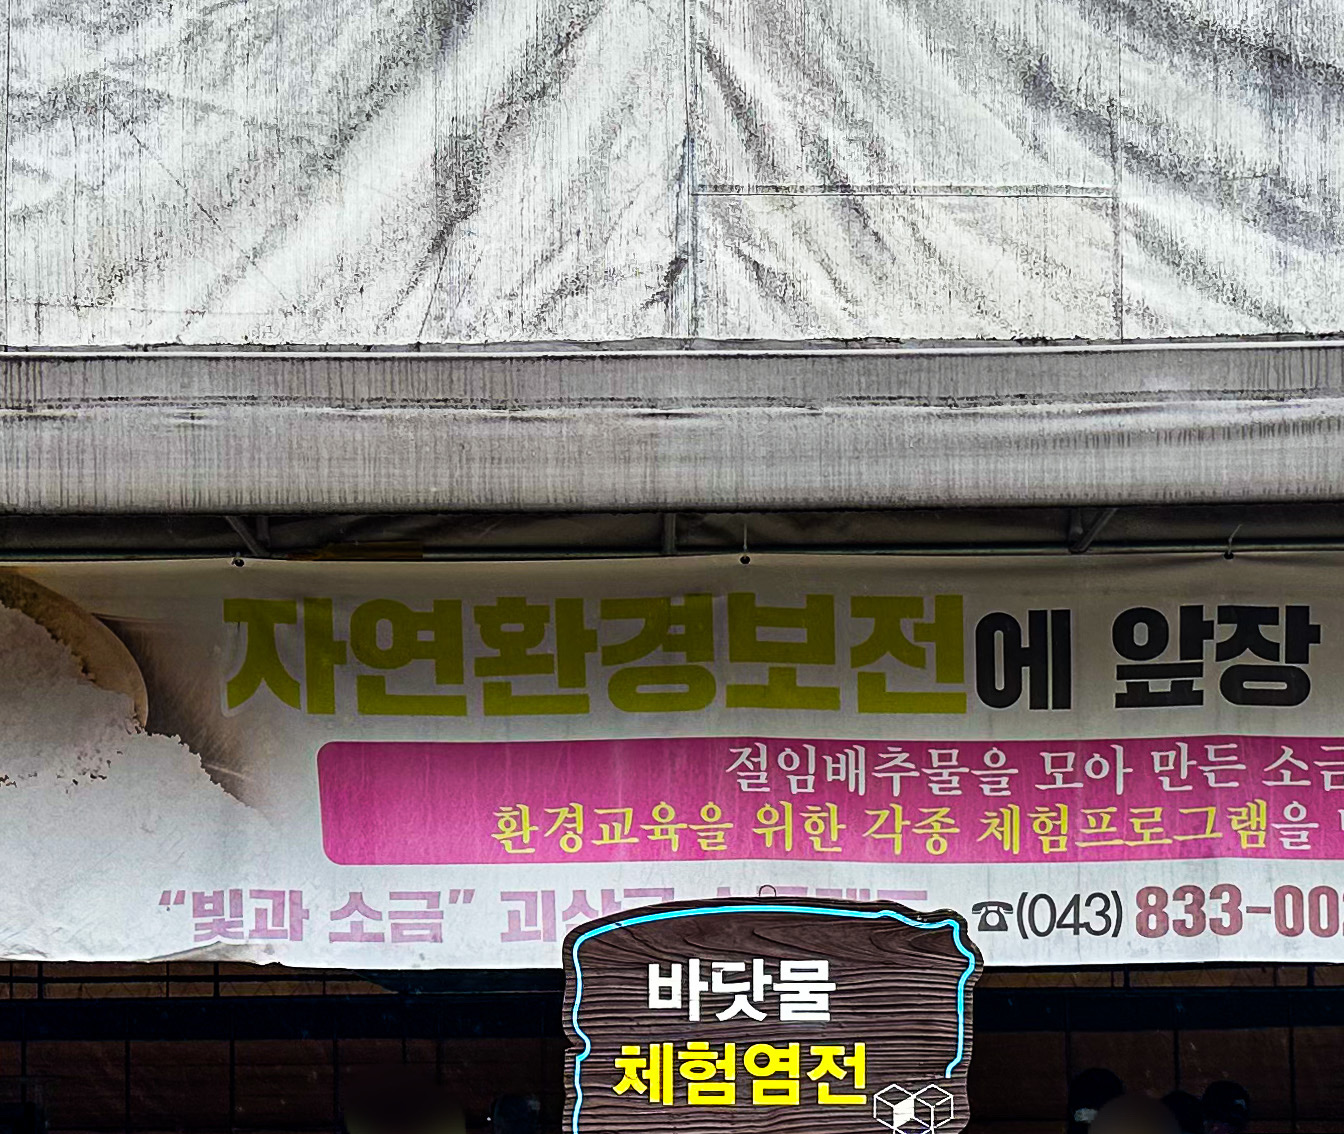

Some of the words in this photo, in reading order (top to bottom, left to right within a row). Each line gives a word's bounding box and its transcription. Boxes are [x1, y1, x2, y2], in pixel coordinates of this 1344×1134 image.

[222, 592, 1071, 716] 자연환경보전에
[1111, 604, 1321, 708] 앞장
[725, 742, 1019, 797] 절임배추물을
[1034, 743, 1133, 796] 모아
[1150, 741, 1247, 792] 만든
[490, 800, 735, 854] 환경교육을
[751, 800, 847, 854] 위한
[862, 801, 960, 855] 각종
[976, 798, 1320, 855] 체험프로그램을
[647, 957, 837, 1023] 바닷물
[611, 1040, 868, 1107] 체험염전
